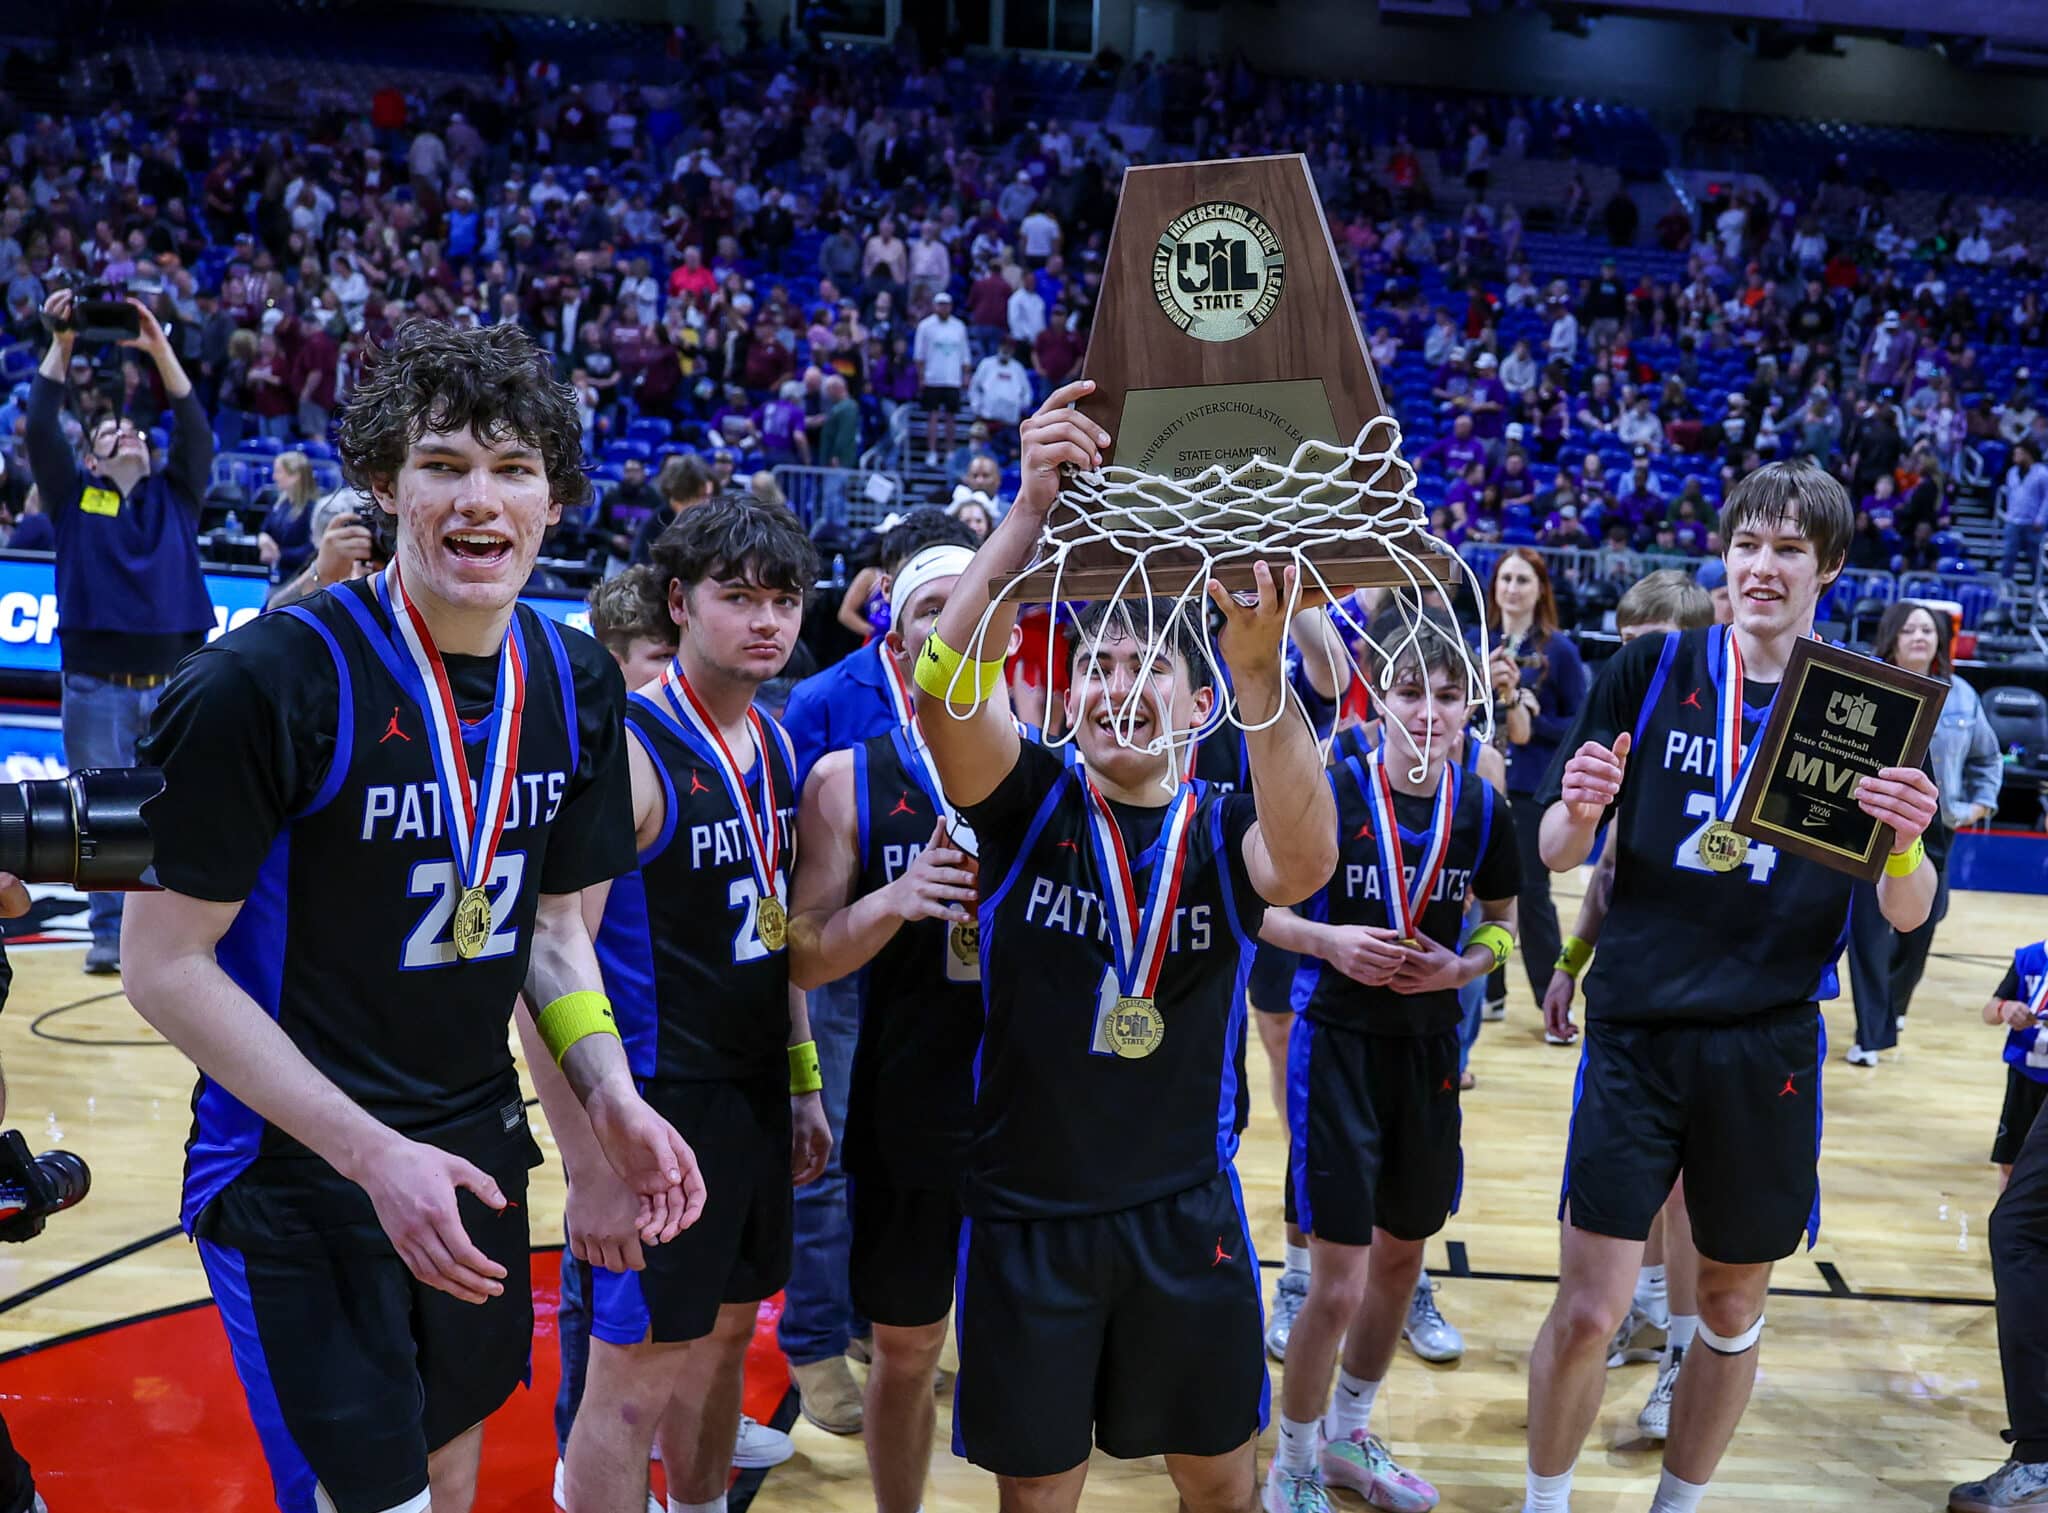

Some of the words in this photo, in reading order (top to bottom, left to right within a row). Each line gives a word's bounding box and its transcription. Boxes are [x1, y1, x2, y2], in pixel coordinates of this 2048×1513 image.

[1167, 203, 1280, 255] INTERSCHOLASTIC
[1153, 248, 1191, 330] UNIVERSITY
[1176, 236, 1258, 293] UIL
[1193, 294, 1243, 310] STATE
[1250, 267, 1283, 324] LEAGUE
[1136, 414, 1186, 473] UNIVERSITY
[1186, 400, 1287, 429] INTERSCHOLASTIC
[1286, 423, 1320, 464] LEAUE
[1178, 449, 1212, 462] STATE
[1214, 446, 1277, 460] CHAMPION
[1792, 732, 1817, 748] State
[1825, 690, 1880, 737] UIL
[1820, 729, 1870, 753] Basketball
[361, 771, 566, 840] PATTS
[1808, 802, 1831, 818] 2026
[691, 808, 794, 869] PATT
[1673, 790, 1780, 886] 24
[400, 850, 526, 970] 22
[1346, 864, 1471, 902] PARTS
[728, 869, 788, 964] 2
[1025, 875, 1211, 953] PATTS
[1117, 1011, 1153, 1037] UIL
[1121, 1037, 1145, 1046] STATE
